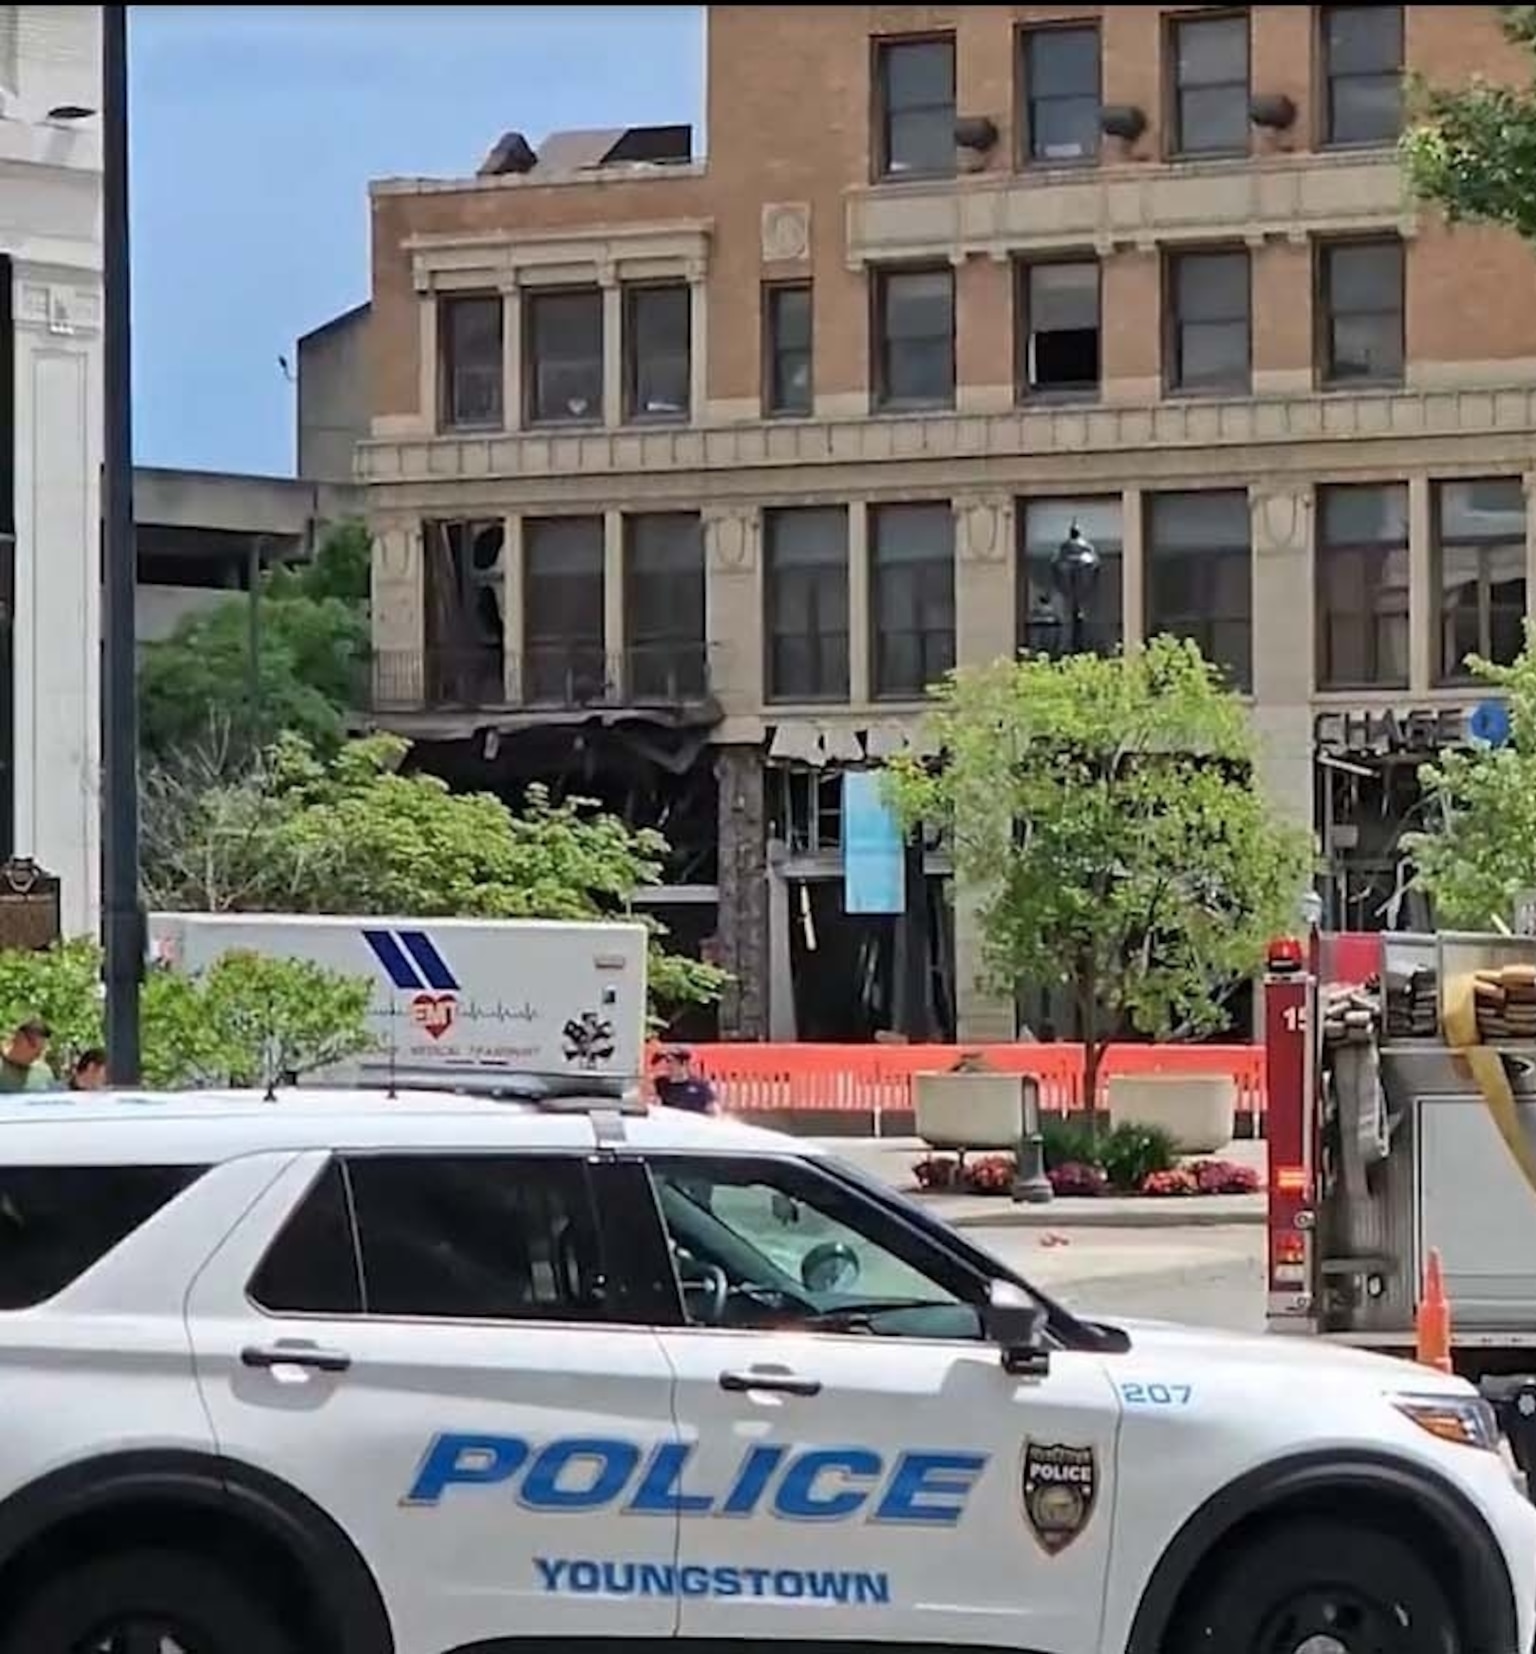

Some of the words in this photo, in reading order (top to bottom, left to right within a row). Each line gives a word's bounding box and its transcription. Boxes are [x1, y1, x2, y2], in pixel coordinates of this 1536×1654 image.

[1315, 708, 1463, 748] CHASE
[1121, 1382, 1192, 1405] 207
[398, 1431, 991, 1527] POLICE
[1030, 1463, 1092, 1482] POLICE
[533, 1557, 891, 1604] YOUNGSTOWN
